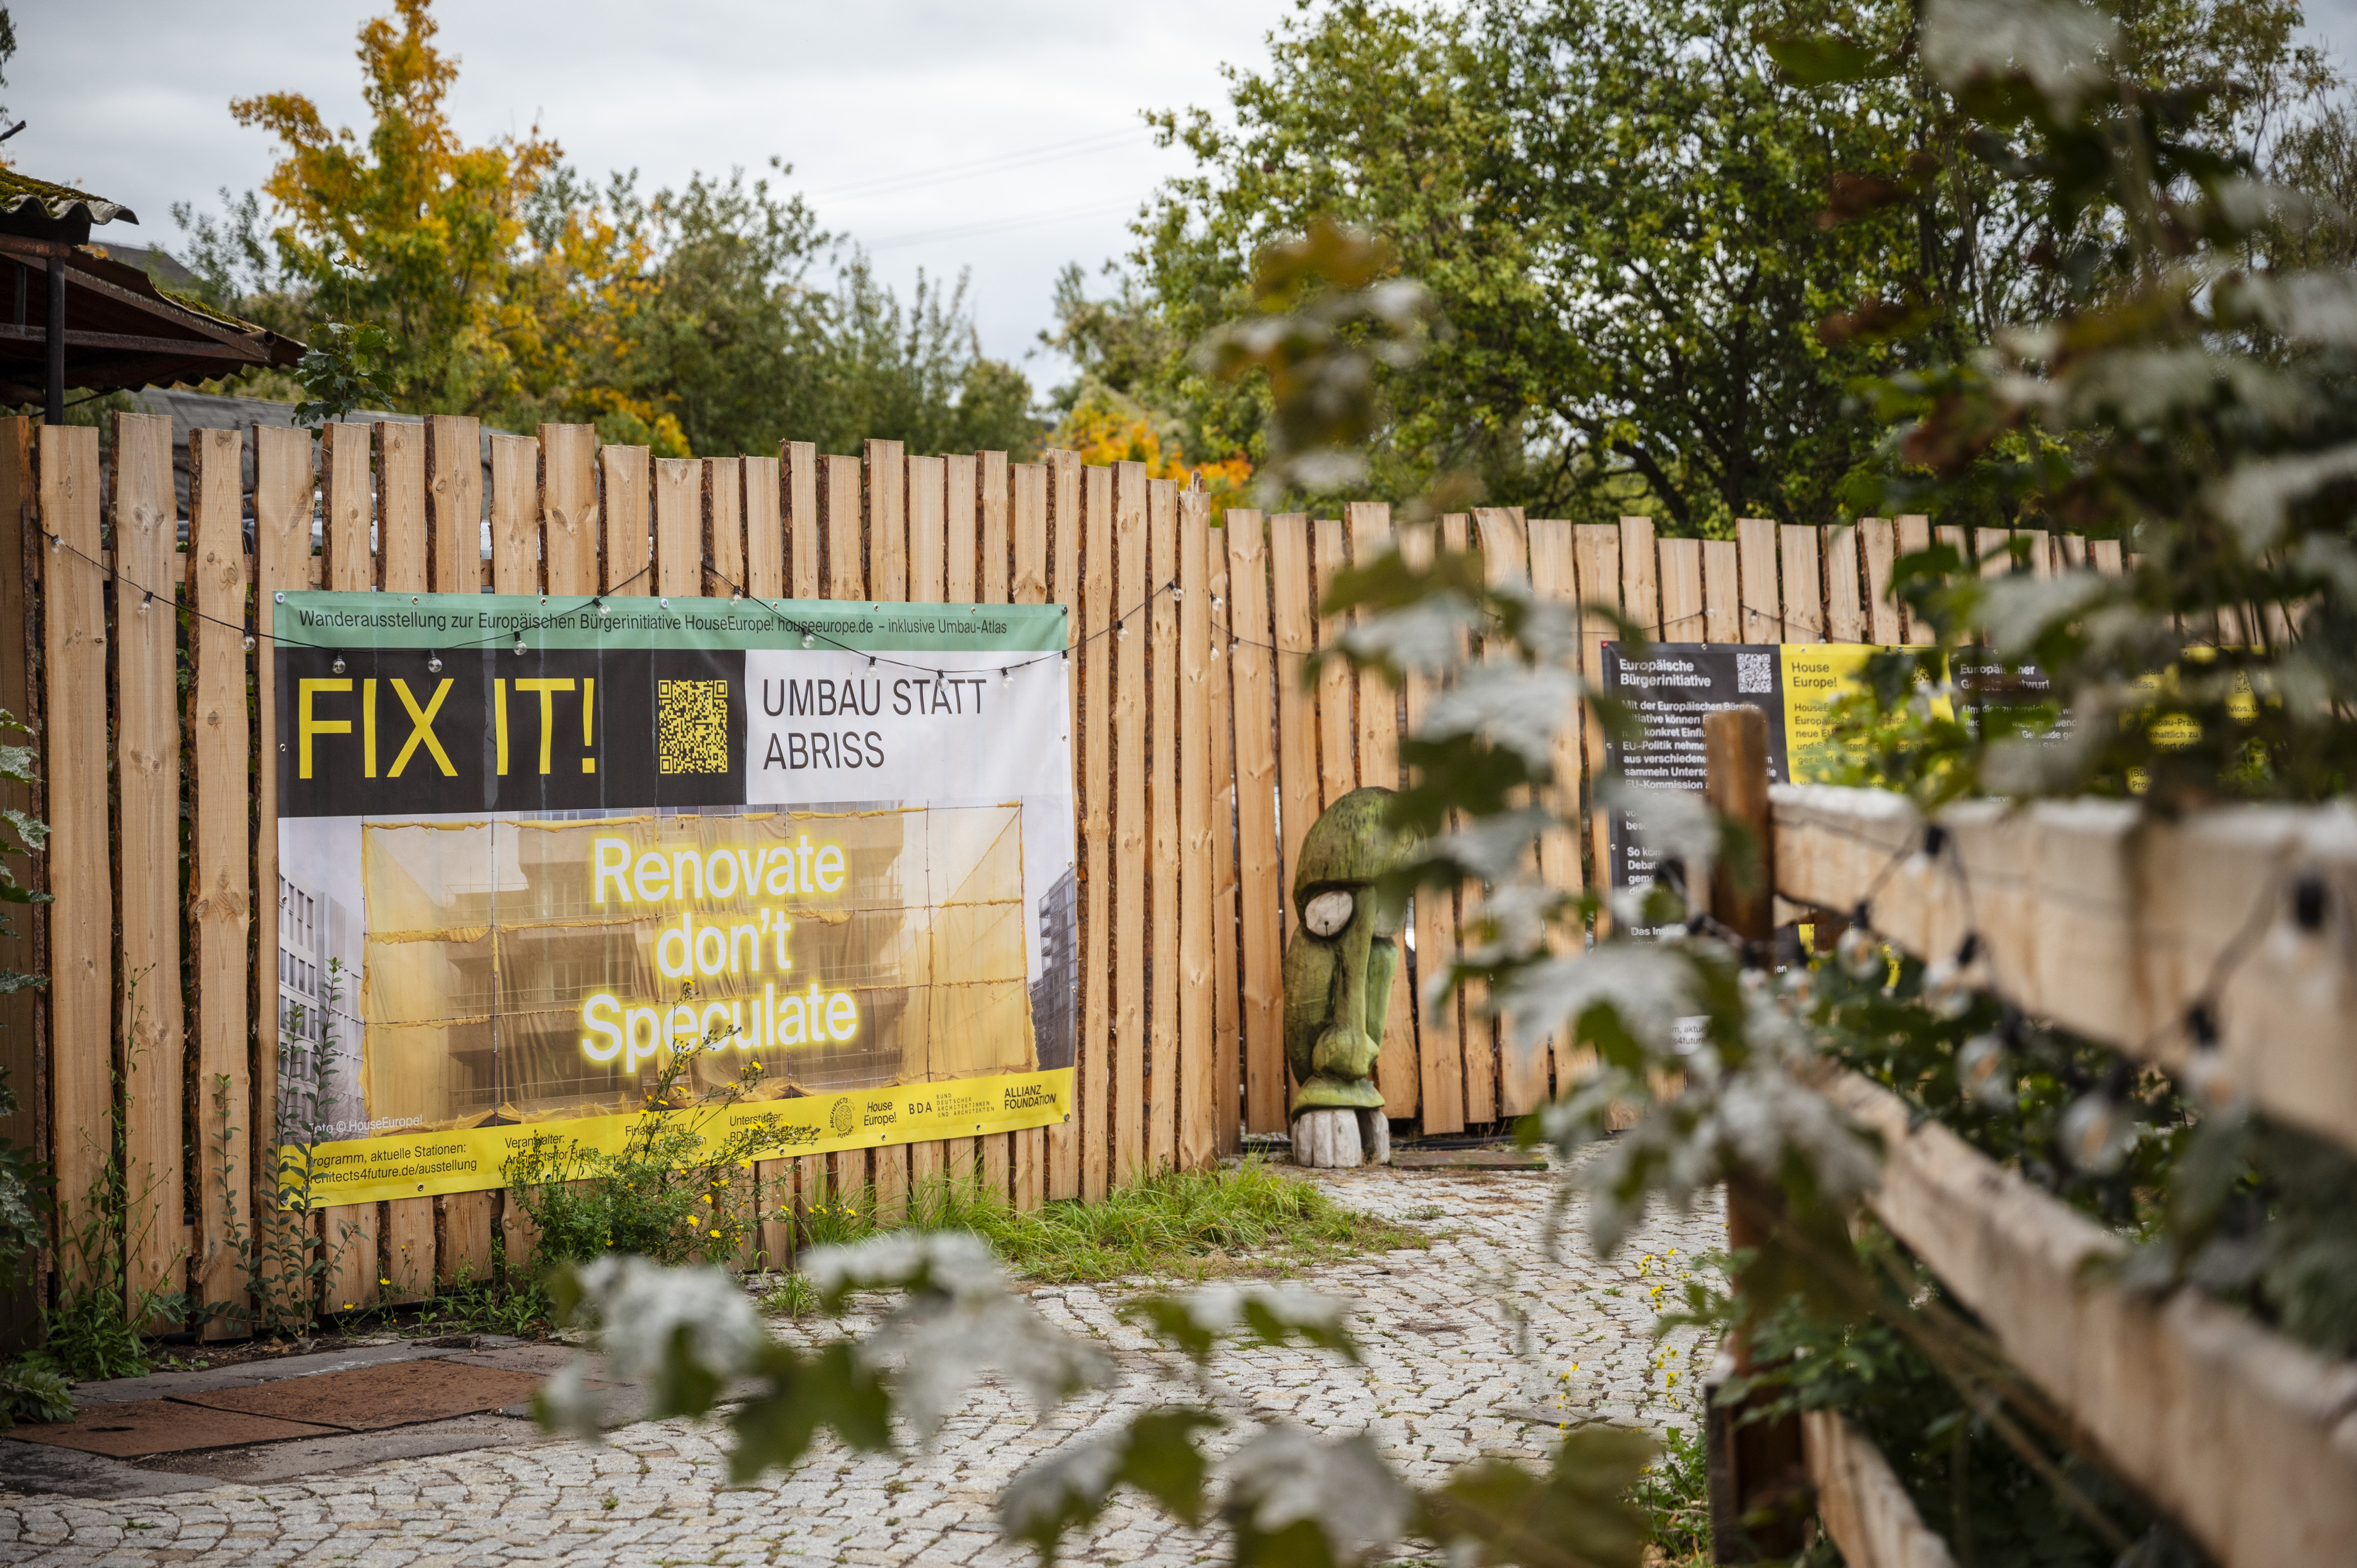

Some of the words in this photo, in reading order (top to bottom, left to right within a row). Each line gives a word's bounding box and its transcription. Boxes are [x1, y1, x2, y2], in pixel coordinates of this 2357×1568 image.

[299, 610, 445, 631] Wanderausstellung
[451, 615, 473, 628] zur
[478, 612, 575, 631] Europäischen
[580, 613, 681, 633] Bürgerinitiative
[685, 615, 773, 633] HouseEurope!
[778, 616, 873, 635] houseeurope.de
[888, 619, 935, 633] inklusive
[938, 619, 1007, 633] Umbau-Atlas
[1619, 658, 1695, 673] Europäische
[1792, 662, 1830, 672] House
[1960, 663, 2035, 676] Europäisher
[1620, 673, 1712, 688] Bürgerinitiative
[1794, 677, 1837, 689] Europe!
[764, 679, 881, 717] UMBAU
[893, 679, 986, 716] STATT
[1622, 699, 1638, 710] Mit
[1640, 700, 1656, 711] der
[1657, 701, 1722, 712] Europäischen
[1629, 713, 1664, 725] itiative
[1665, 714, 1701, 724] können
[299, 678, 458, 779] FIX
[494, 678, 595, 775] IT!
[1644, 727, 1681, 737] konkret
[764, 731, 885, 771] ABRISS
[1623, 740, 1672, 750] EU-Politik
[1797, 742, 1814, 750] und
[1623, 755, 1641, 764] aus
[1643, 754, 1708, 764] verschiedene
[1798, 757, 1814, 765] ger
[1624, 767, 1669, 777] sammeln
[1626, 780, 1703, 790] EU-Kommission
[1627, 846, 1640, 857] So
[594, 835, 844, 904] Renovate
[1631, 927, 1651, 936] Das
[582, 983, 856, 1073] Speculate
[1005, 1085, 1041, 1099] ALLIANZ
[867, 1101, 893, 1113] House
[937, 1097, 972, 1106] DEUTSCHER
[937, 1101, 990, 1112] ARCHITEKTINNEN
[1005, 1094, 1057, 1110] FOUNDATION
[830, 1097, 849, 1128] ARCHITECTS
[909, 1102, 932, 1115] BDA
[953, 1107, 995, 1116] ARCHITEKTEN
[349, 1114, 423, 1133] HouseEurope!
[864, 1112, 897, 1127] Europe!
[625, 1123, 686, 1137] Finazierung:
[837, 1124, 854, 1138] FUTURE
[505, 1134, 565, 1148] Veranalter:
[626, 1141, 656, 1153] Alliaz
[371, 1148, 411, 1163] aktuelle
[414, 1144, 467, 1158] Stationen:
[304, 1159, 477, 1184] rchitects4future.de/ausstellung
